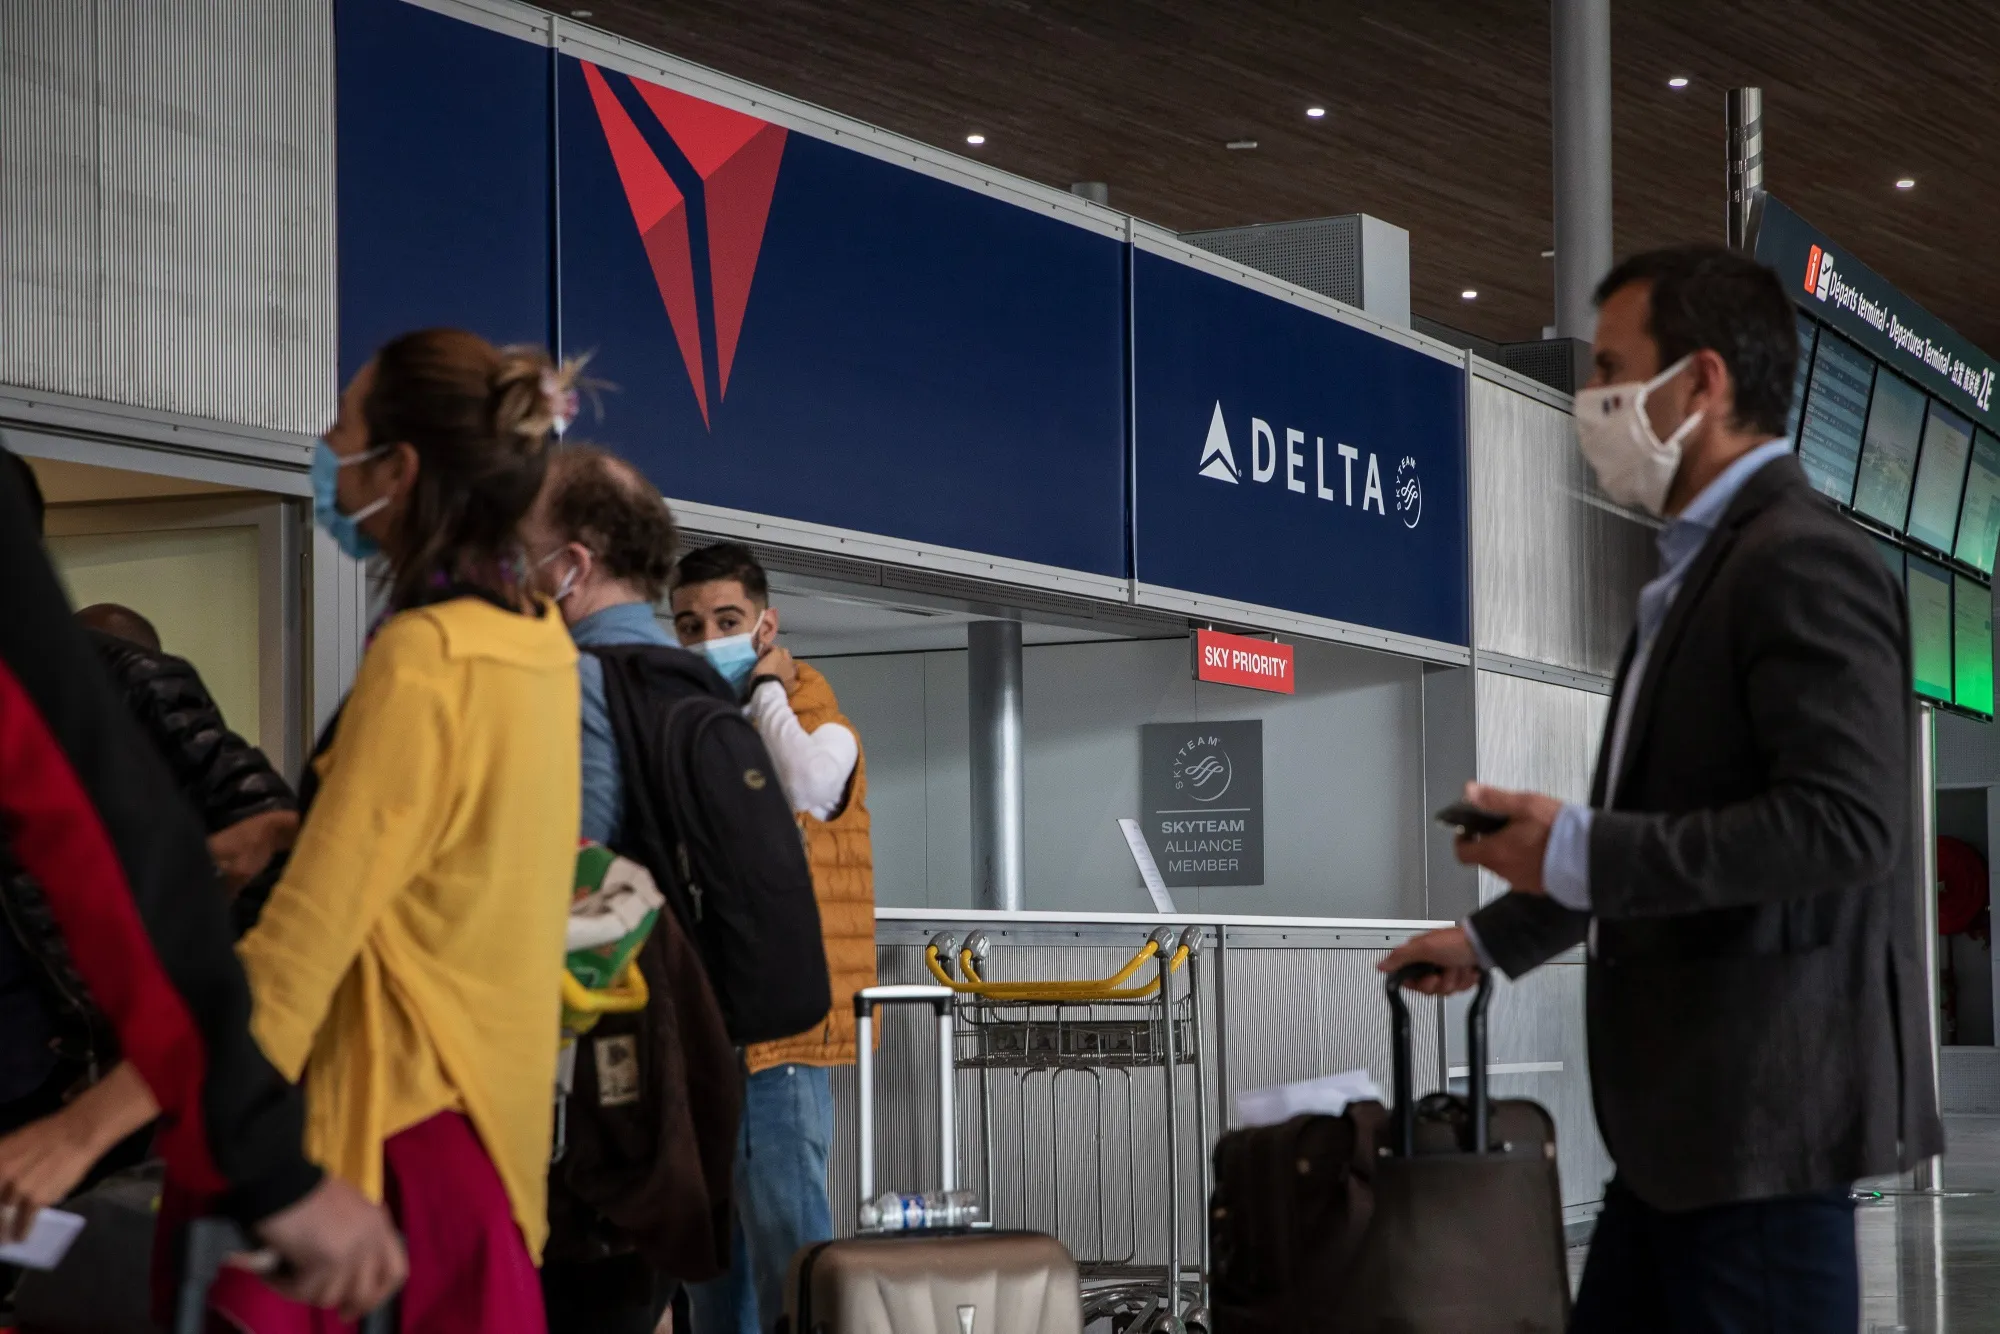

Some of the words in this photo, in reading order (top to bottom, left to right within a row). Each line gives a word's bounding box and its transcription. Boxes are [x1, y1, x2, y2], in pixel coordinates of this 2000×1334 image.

[1829, 271, 1858, 311] Départs
[1857, 293, 1888, 332] terminal
[1889, 314, 1925, 358] Departures
[1924, 338, 1951, 376] Terminal
[1976, 367, 1996, 412] 2E
[1252, 417, 1385, 515] DELTA
[1396, 455, 1416, 511] SKYTEAM
[1205, 646, 1229, 669] SKY
[1233, 650, 1286, 678] PRIORITY
[1174, 736, 1218, 790] SKYTEAM
[1161, 819, 1245, 834] SKYTEAM
[1165, 839, 1242, 853] ALLIANCE
[1168, 859, 1239, 872] MEMBER
